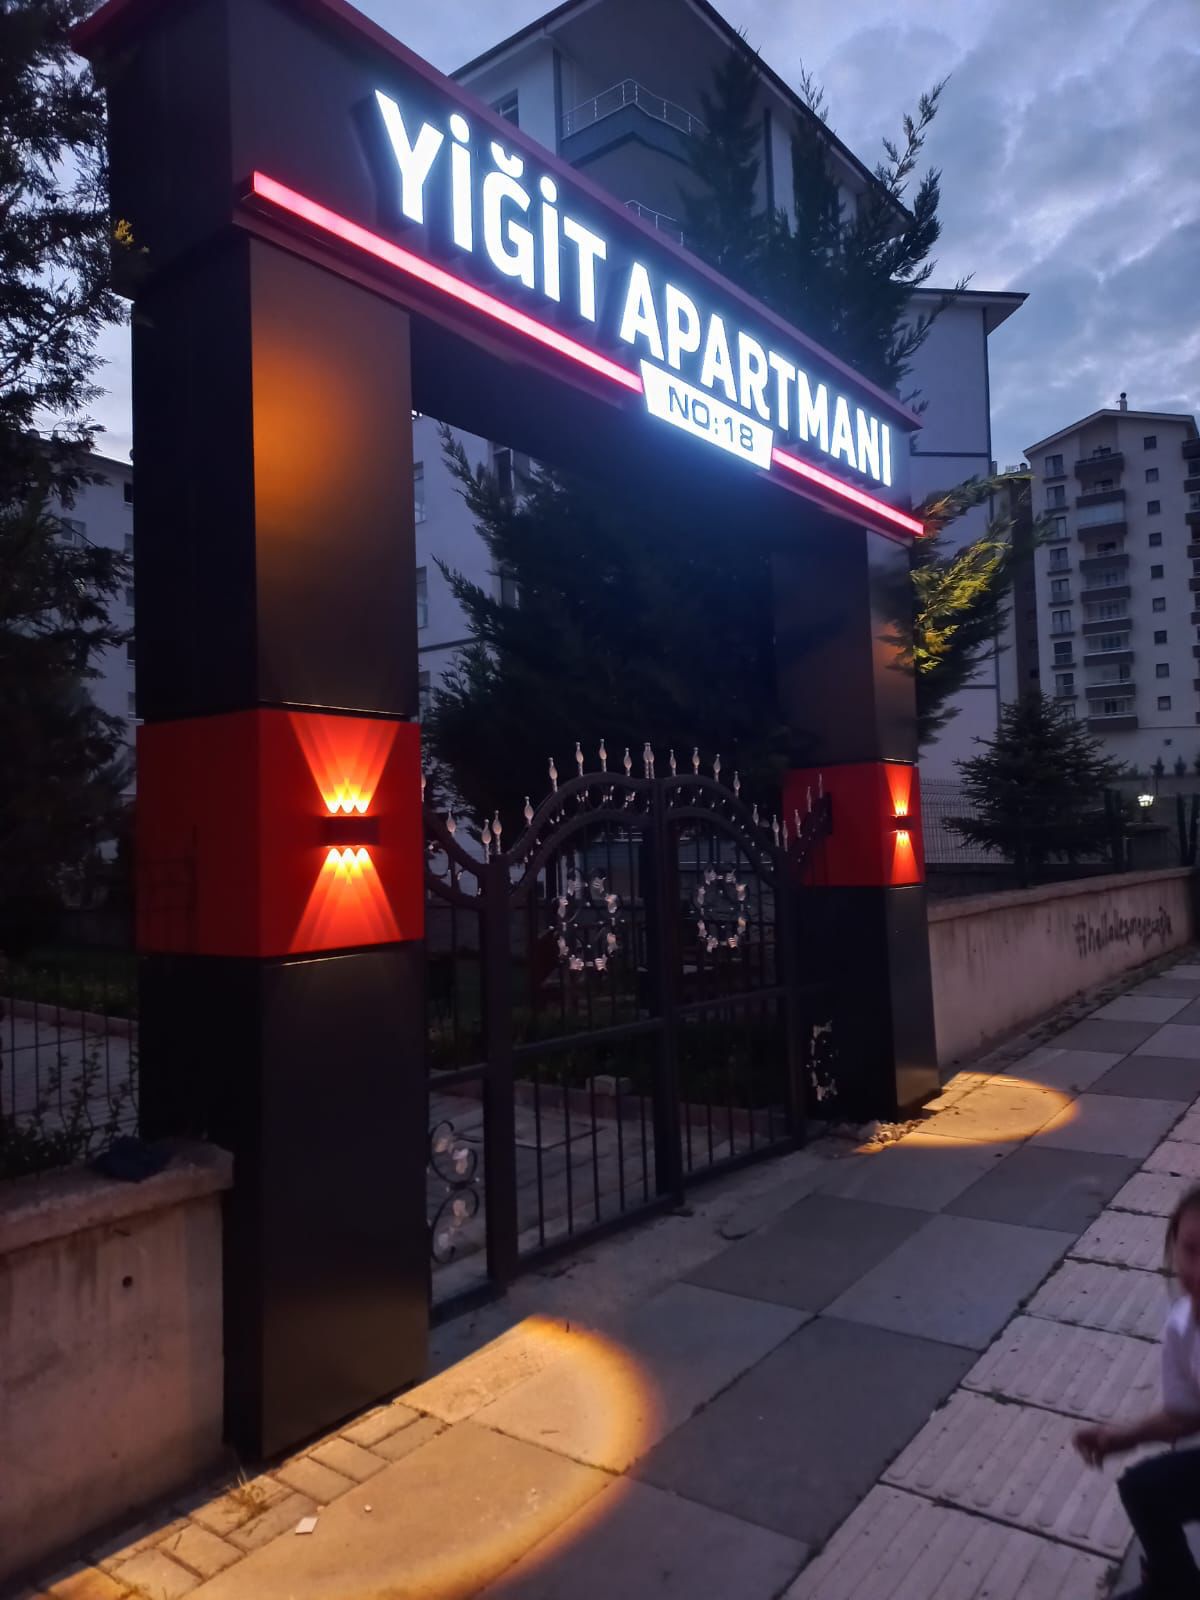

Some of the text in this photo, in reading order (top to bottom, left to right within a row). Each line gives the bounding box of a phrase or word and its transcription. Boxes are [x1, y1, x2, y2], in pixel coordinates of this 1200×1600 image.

[374, 89, 893, 487] YİĞİT APARTMANI
[668, 384, 754, 452] NO:18
